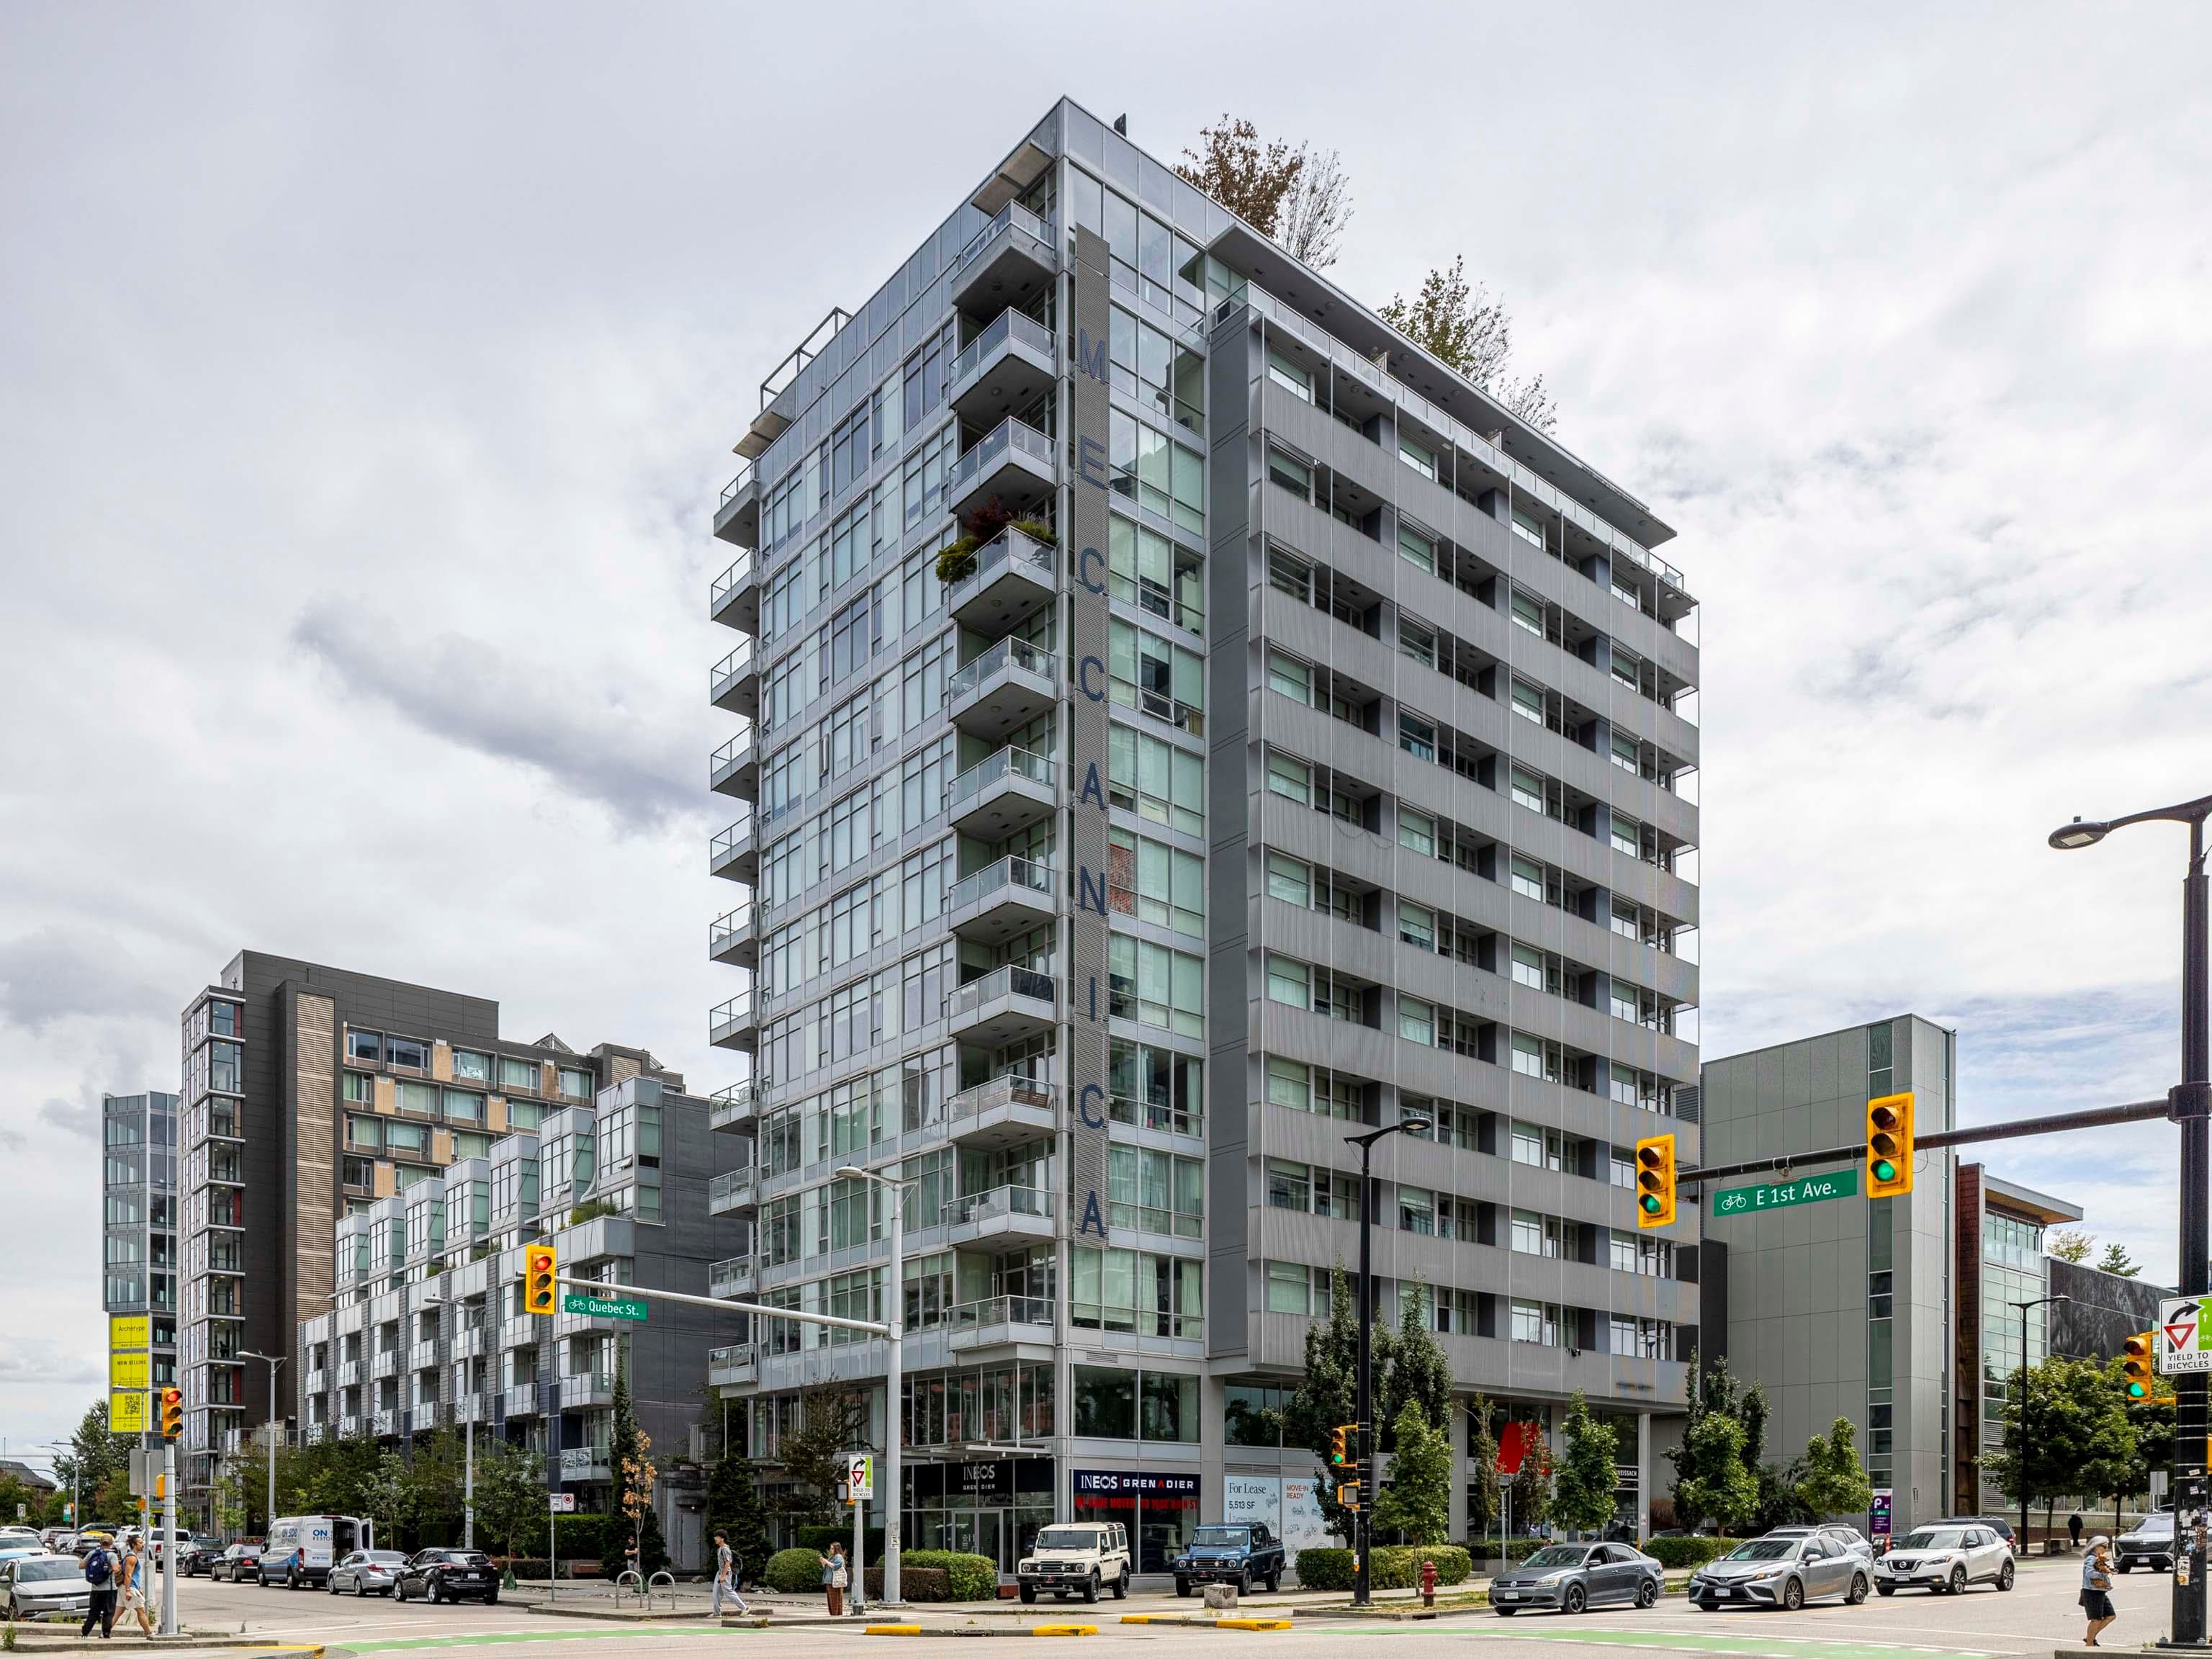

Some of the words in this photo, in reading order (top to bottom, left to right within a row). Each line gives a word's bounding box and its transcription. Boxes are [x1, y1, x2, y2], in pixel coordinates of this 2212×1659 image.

[1081, 328, 1106, 1236] MECCANICA
[1756, 1190, 1765, 1205] E
[1771, 1187, 1795, 1203] 1st
[1802, 1182, 1837, 1198] Ave.
[588, 1300, 624, 1314] Quebec
[626, 1304, 639, 1316] St.
[2167, 1360, 2209, 1370] BICYCLES
[963, 1465, 995, 1480] INEOS
[1081, 1475, 1118, 1489] INEOS
[1123, 1478, 1194, 1489] GRENADIER
[1229, 1483, 1242, 1494] For
[1244, 1483, 1267, 1494] Lease
[1228, 1501, 1245, 1510] 5,513
